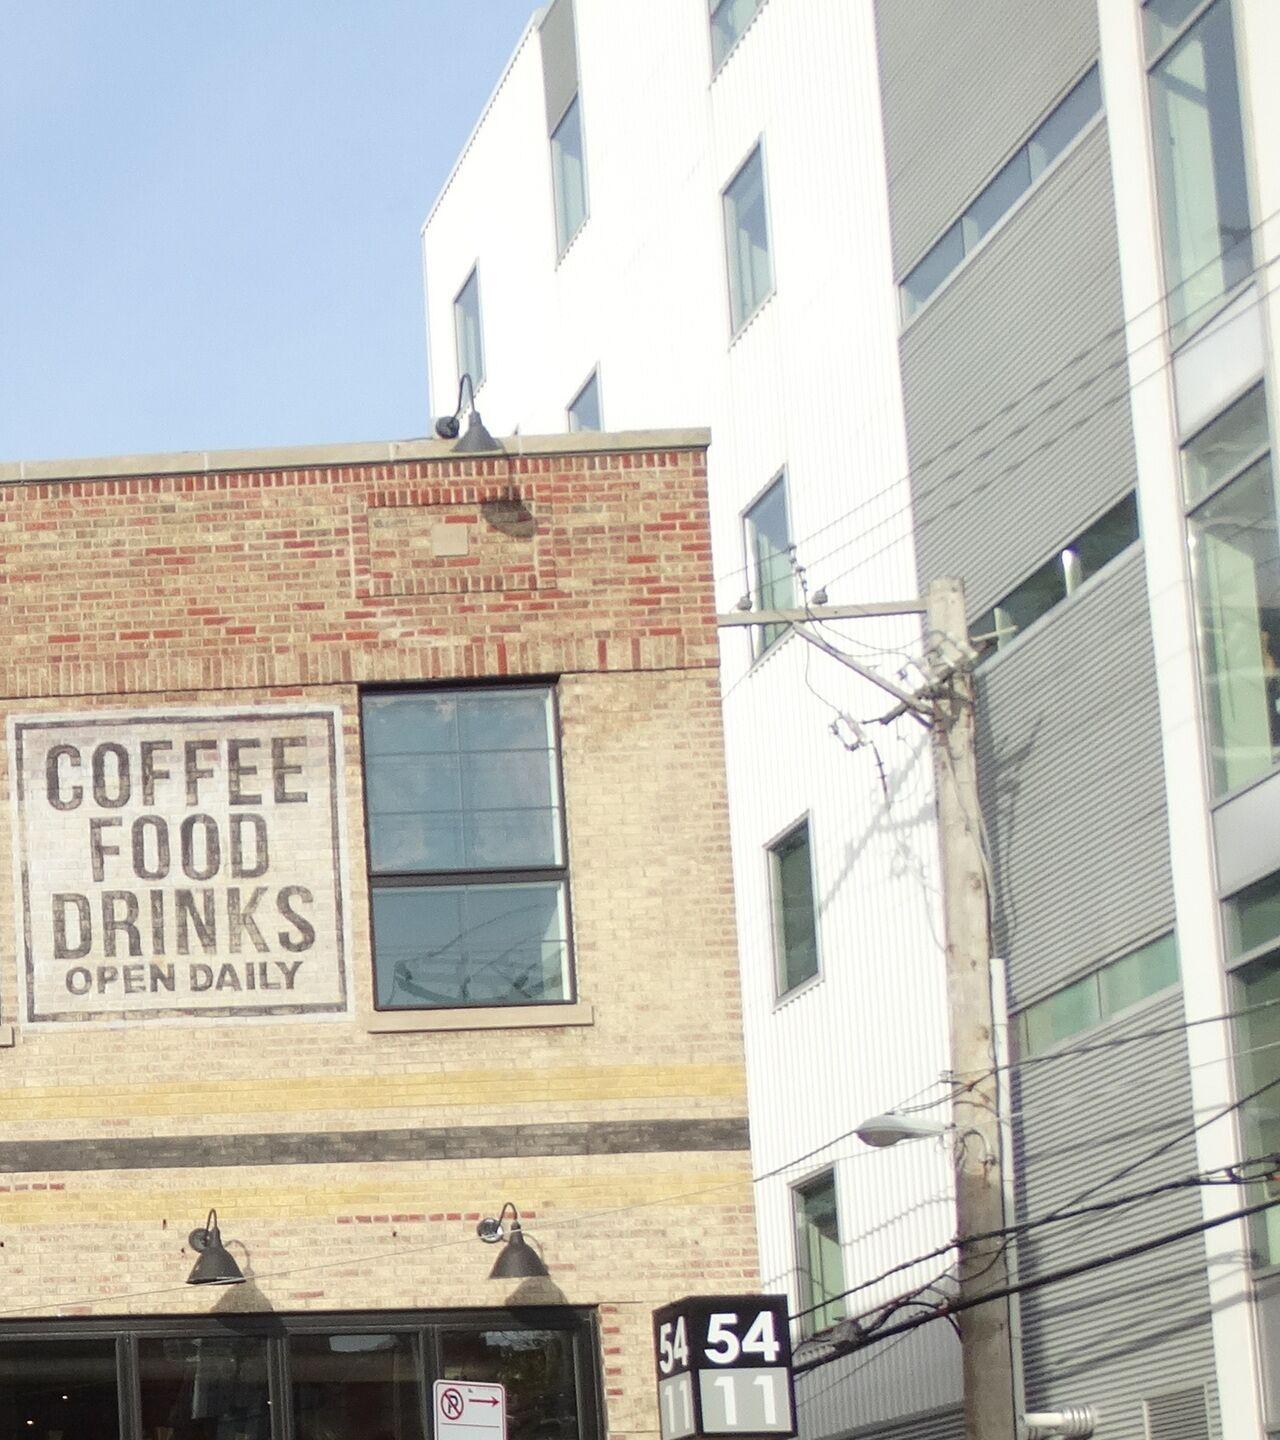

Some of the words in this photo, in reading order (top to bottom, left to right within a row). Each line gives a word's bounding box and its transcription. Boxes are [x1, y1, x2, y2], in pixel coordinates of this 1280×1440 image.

[45, 735, 308, 811] COFFEE
[89, 813, 270, 883] FOOD
[51, 885, 316, 960] DRINKS
[65, 963, 176, 996] OPEN
[189, 960, 304, 992] DAILY
[659, 1315, 689, 1374] 54
[704, 1310, 780, 1365] 54
[663, 1378, 691, 1434] 11
[713, 1374, 778, 1426] 11
